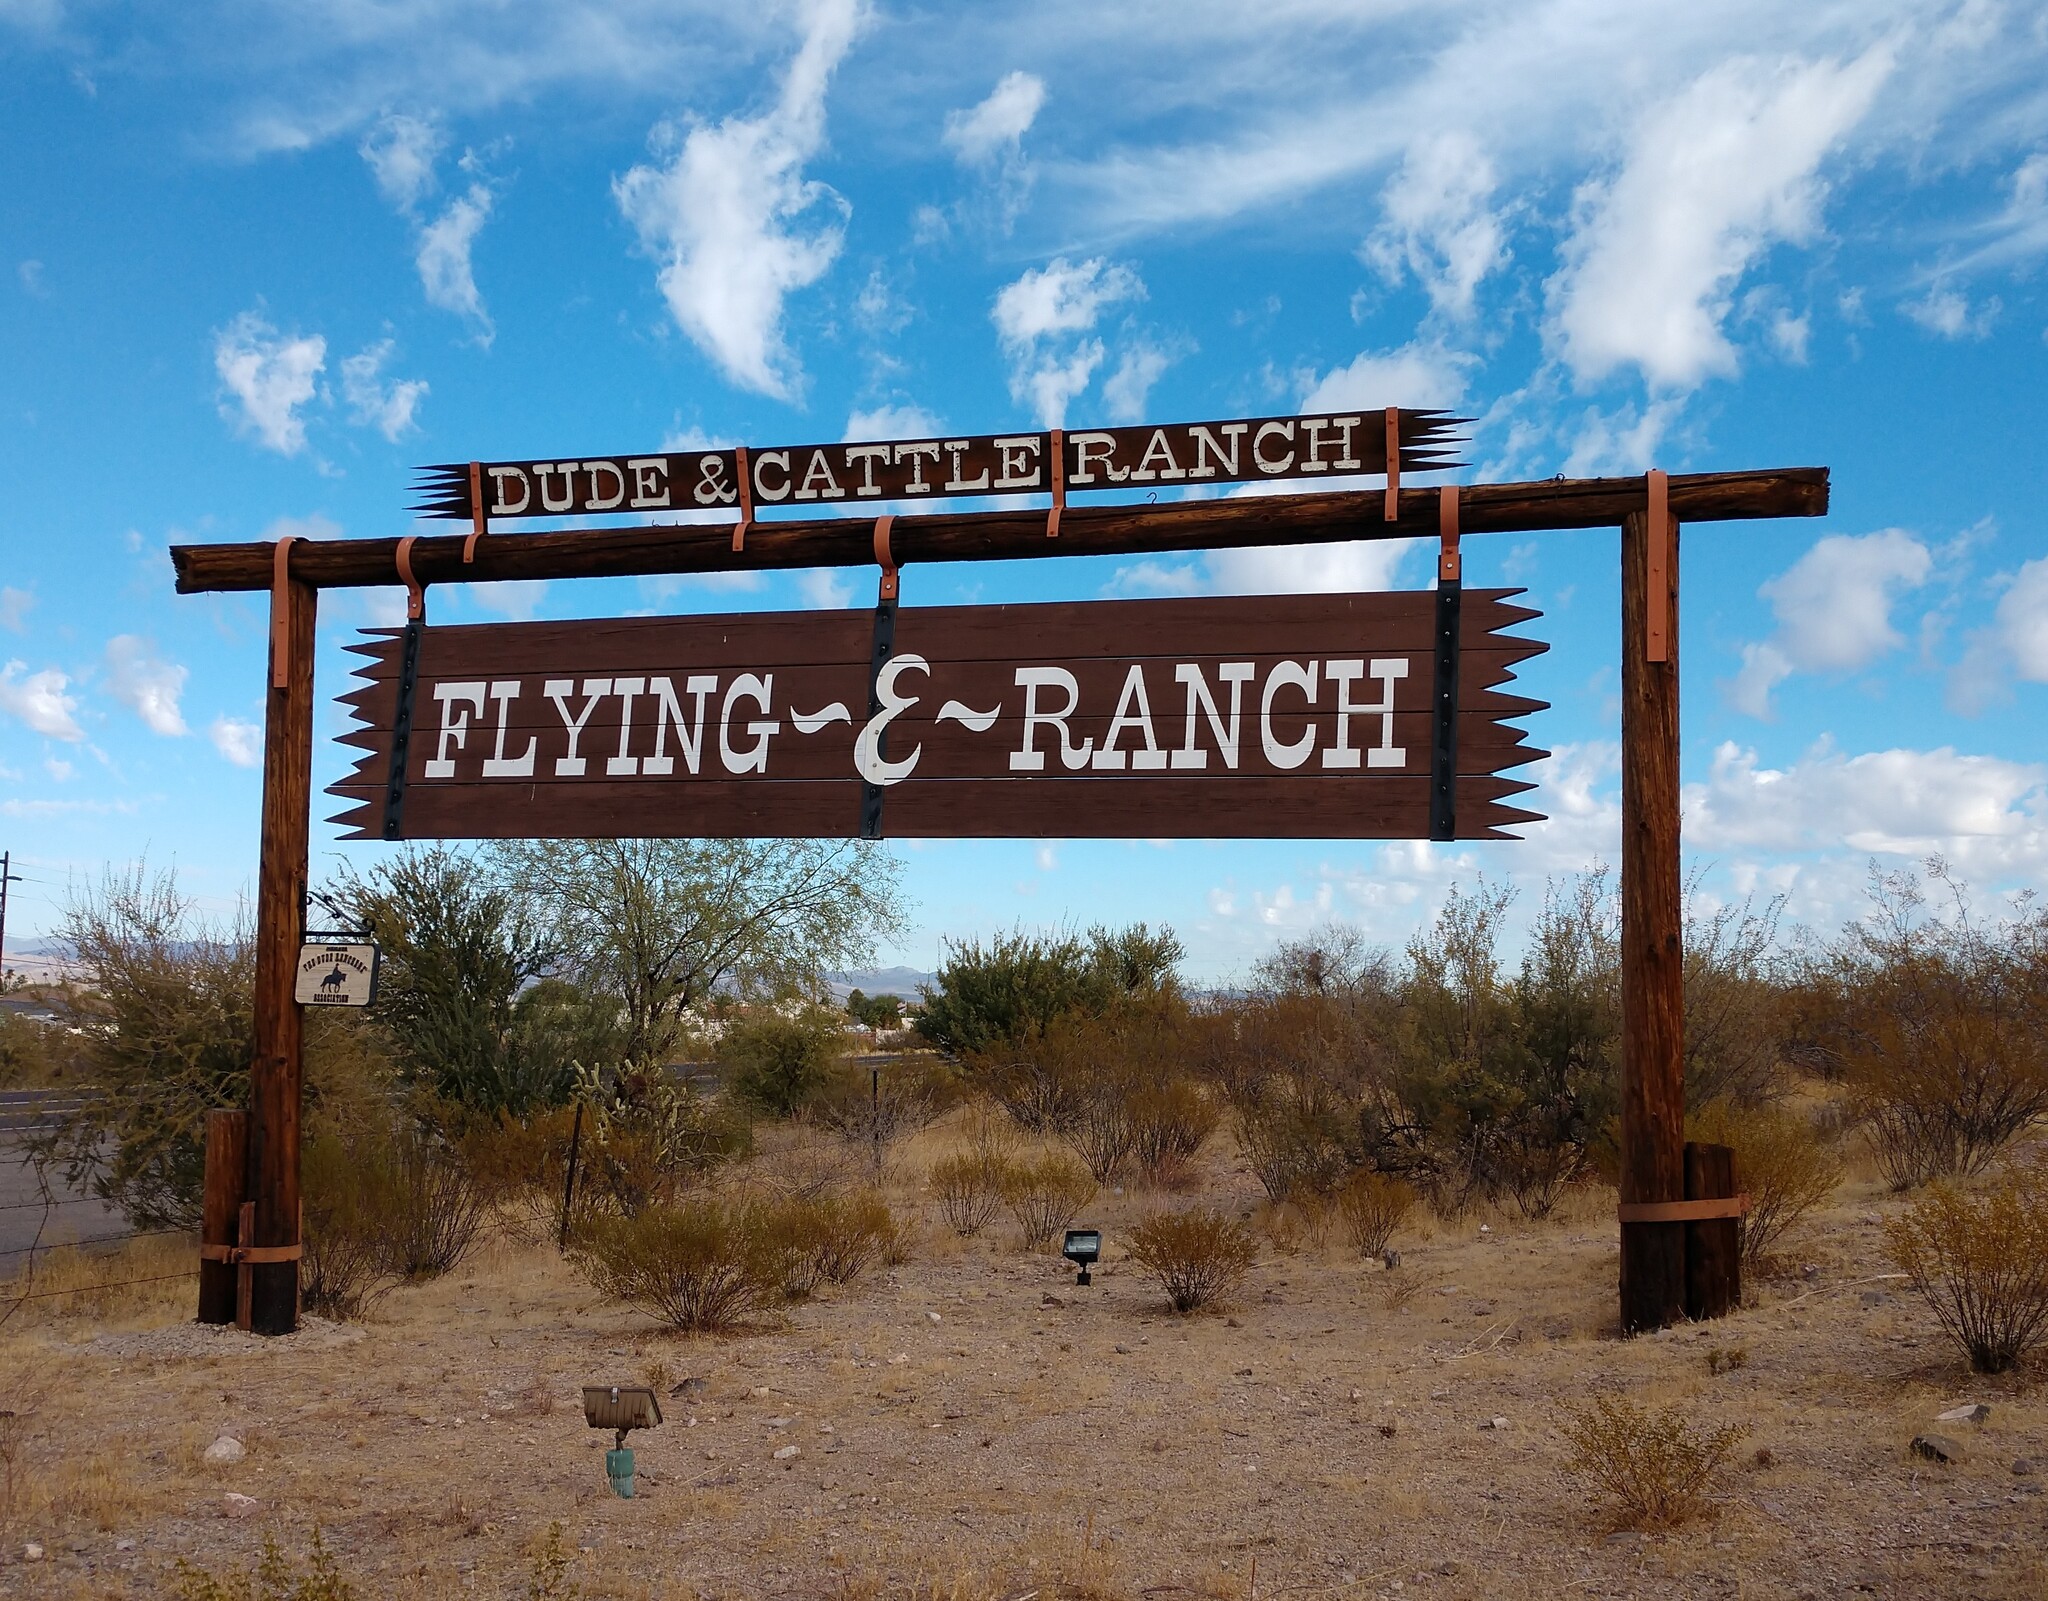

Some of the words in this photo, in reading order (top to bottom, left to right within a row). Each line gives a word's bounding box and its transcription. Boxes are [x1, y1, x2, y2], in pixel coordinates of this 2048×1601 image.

[488, 459, 671, 517] DUDE
[693, 455, 738, 505] &
[753, 435, 1045, 503] CATTLE
[1067, 414, 1363, 485] RANCH
[424, 673, 780, 779] FLYING
[1008, 657, 1410, 771] RANCH
[303, 958, 316, 972] THE
[317, 953, 333, 965] DUDE
[313, 993, 349, 1003] ASSOCIATION
